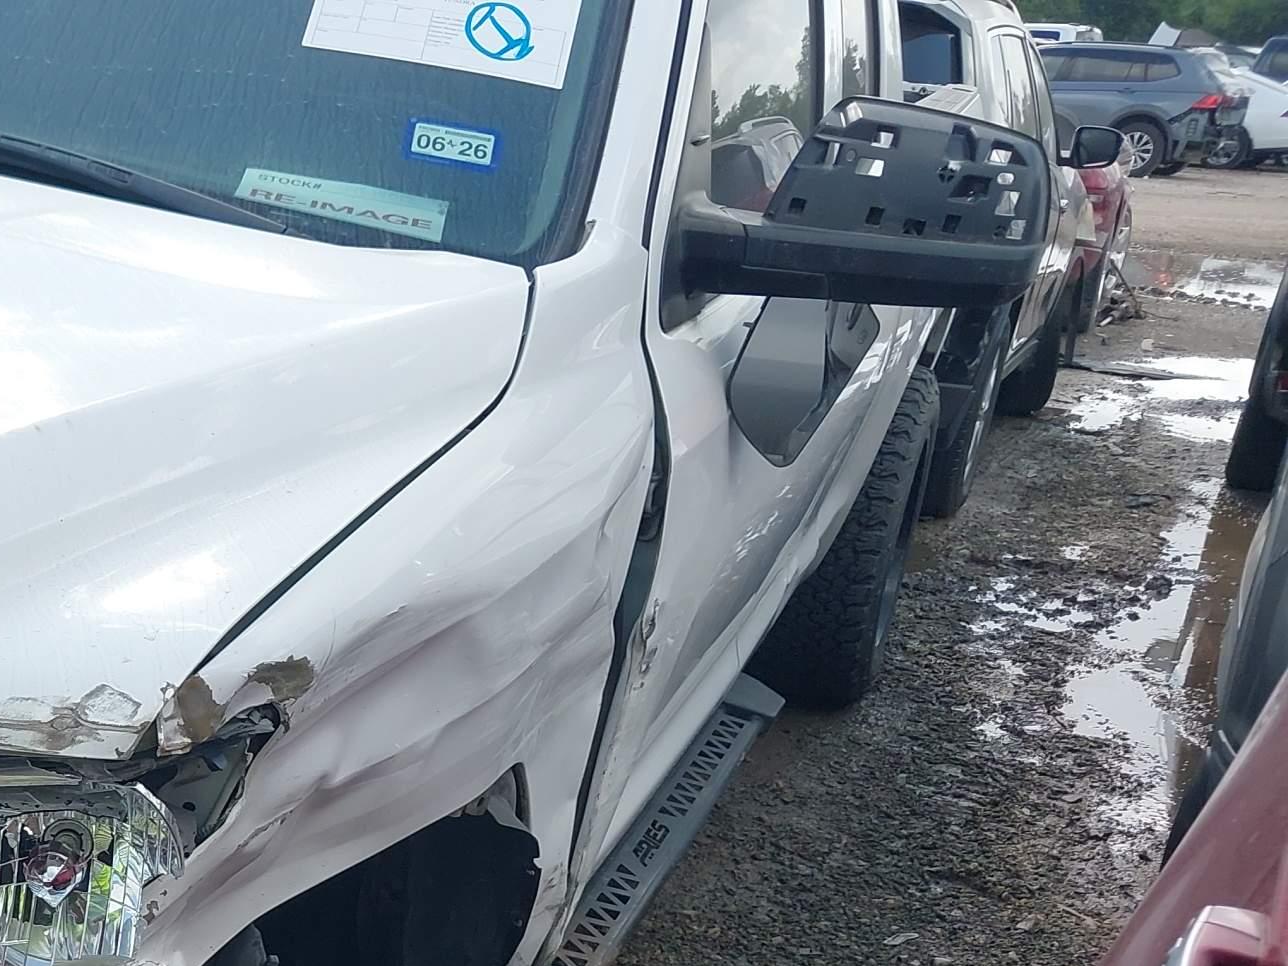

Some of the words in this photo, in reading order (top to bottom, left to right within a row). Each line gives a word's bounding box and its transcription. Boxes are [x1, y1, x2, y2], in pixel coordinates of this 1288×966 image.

[416, 133, 446, 152] 06
[457, 140, 489, 160] 26
[257, 173, 322, 191] STOCK#
[248, 187, 433, 231] RE-IMAGE
[632, 818, 670, 868] ARIES
